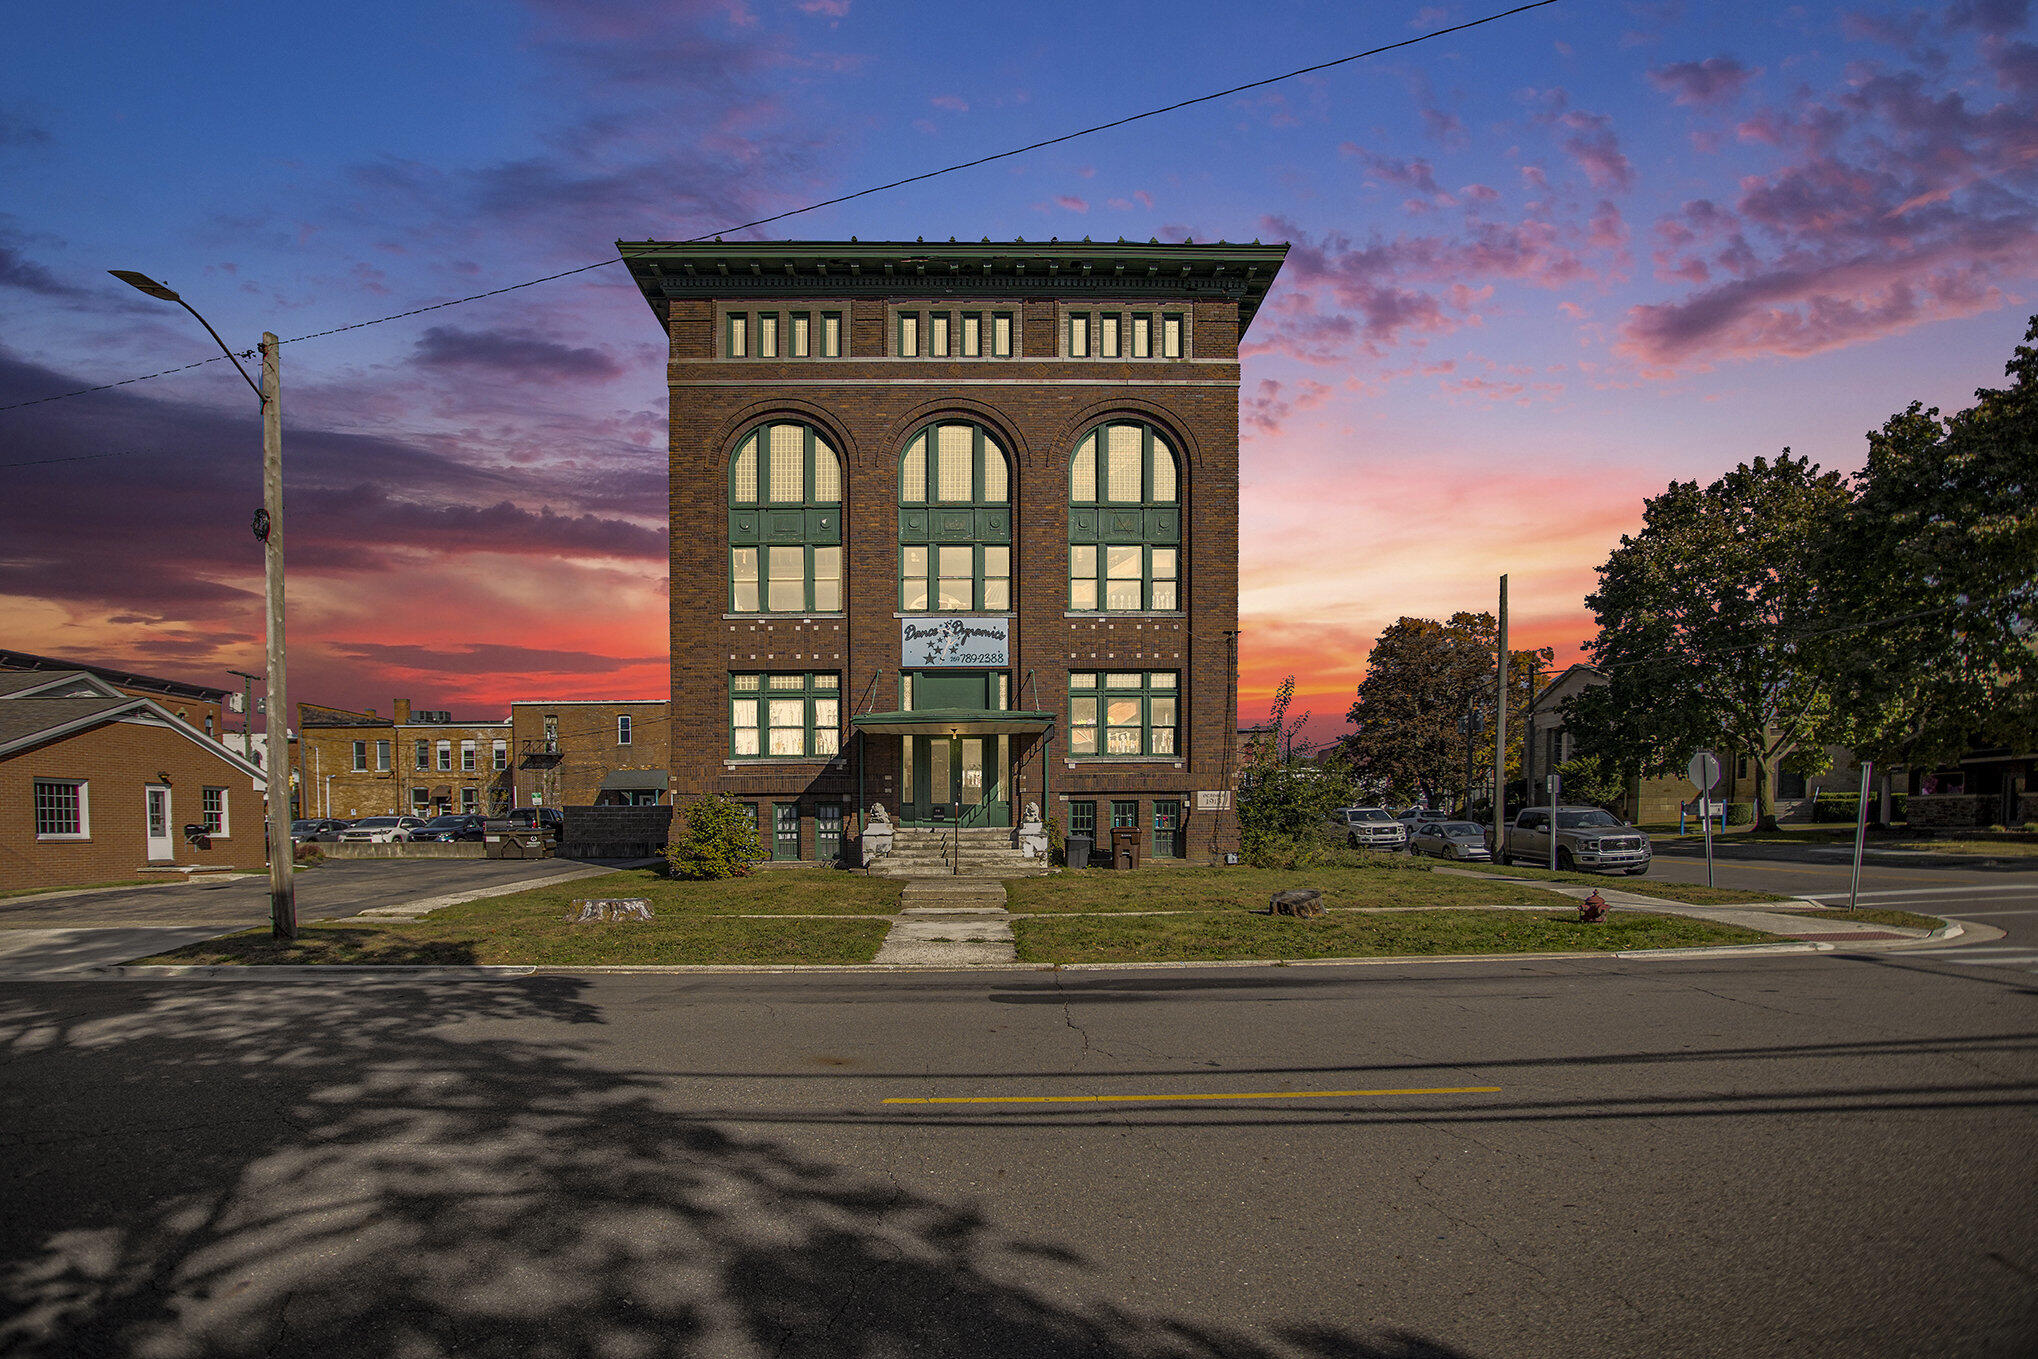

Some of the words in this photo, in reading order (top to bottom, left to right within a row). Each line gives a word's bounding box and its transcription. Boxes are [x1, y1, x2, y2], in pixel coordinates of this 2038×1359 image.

[904, 624, 939, 641] Dance
[951, 620, 1006, 646] Dynamics
[960, 653, 1004, 663] 789-2388
